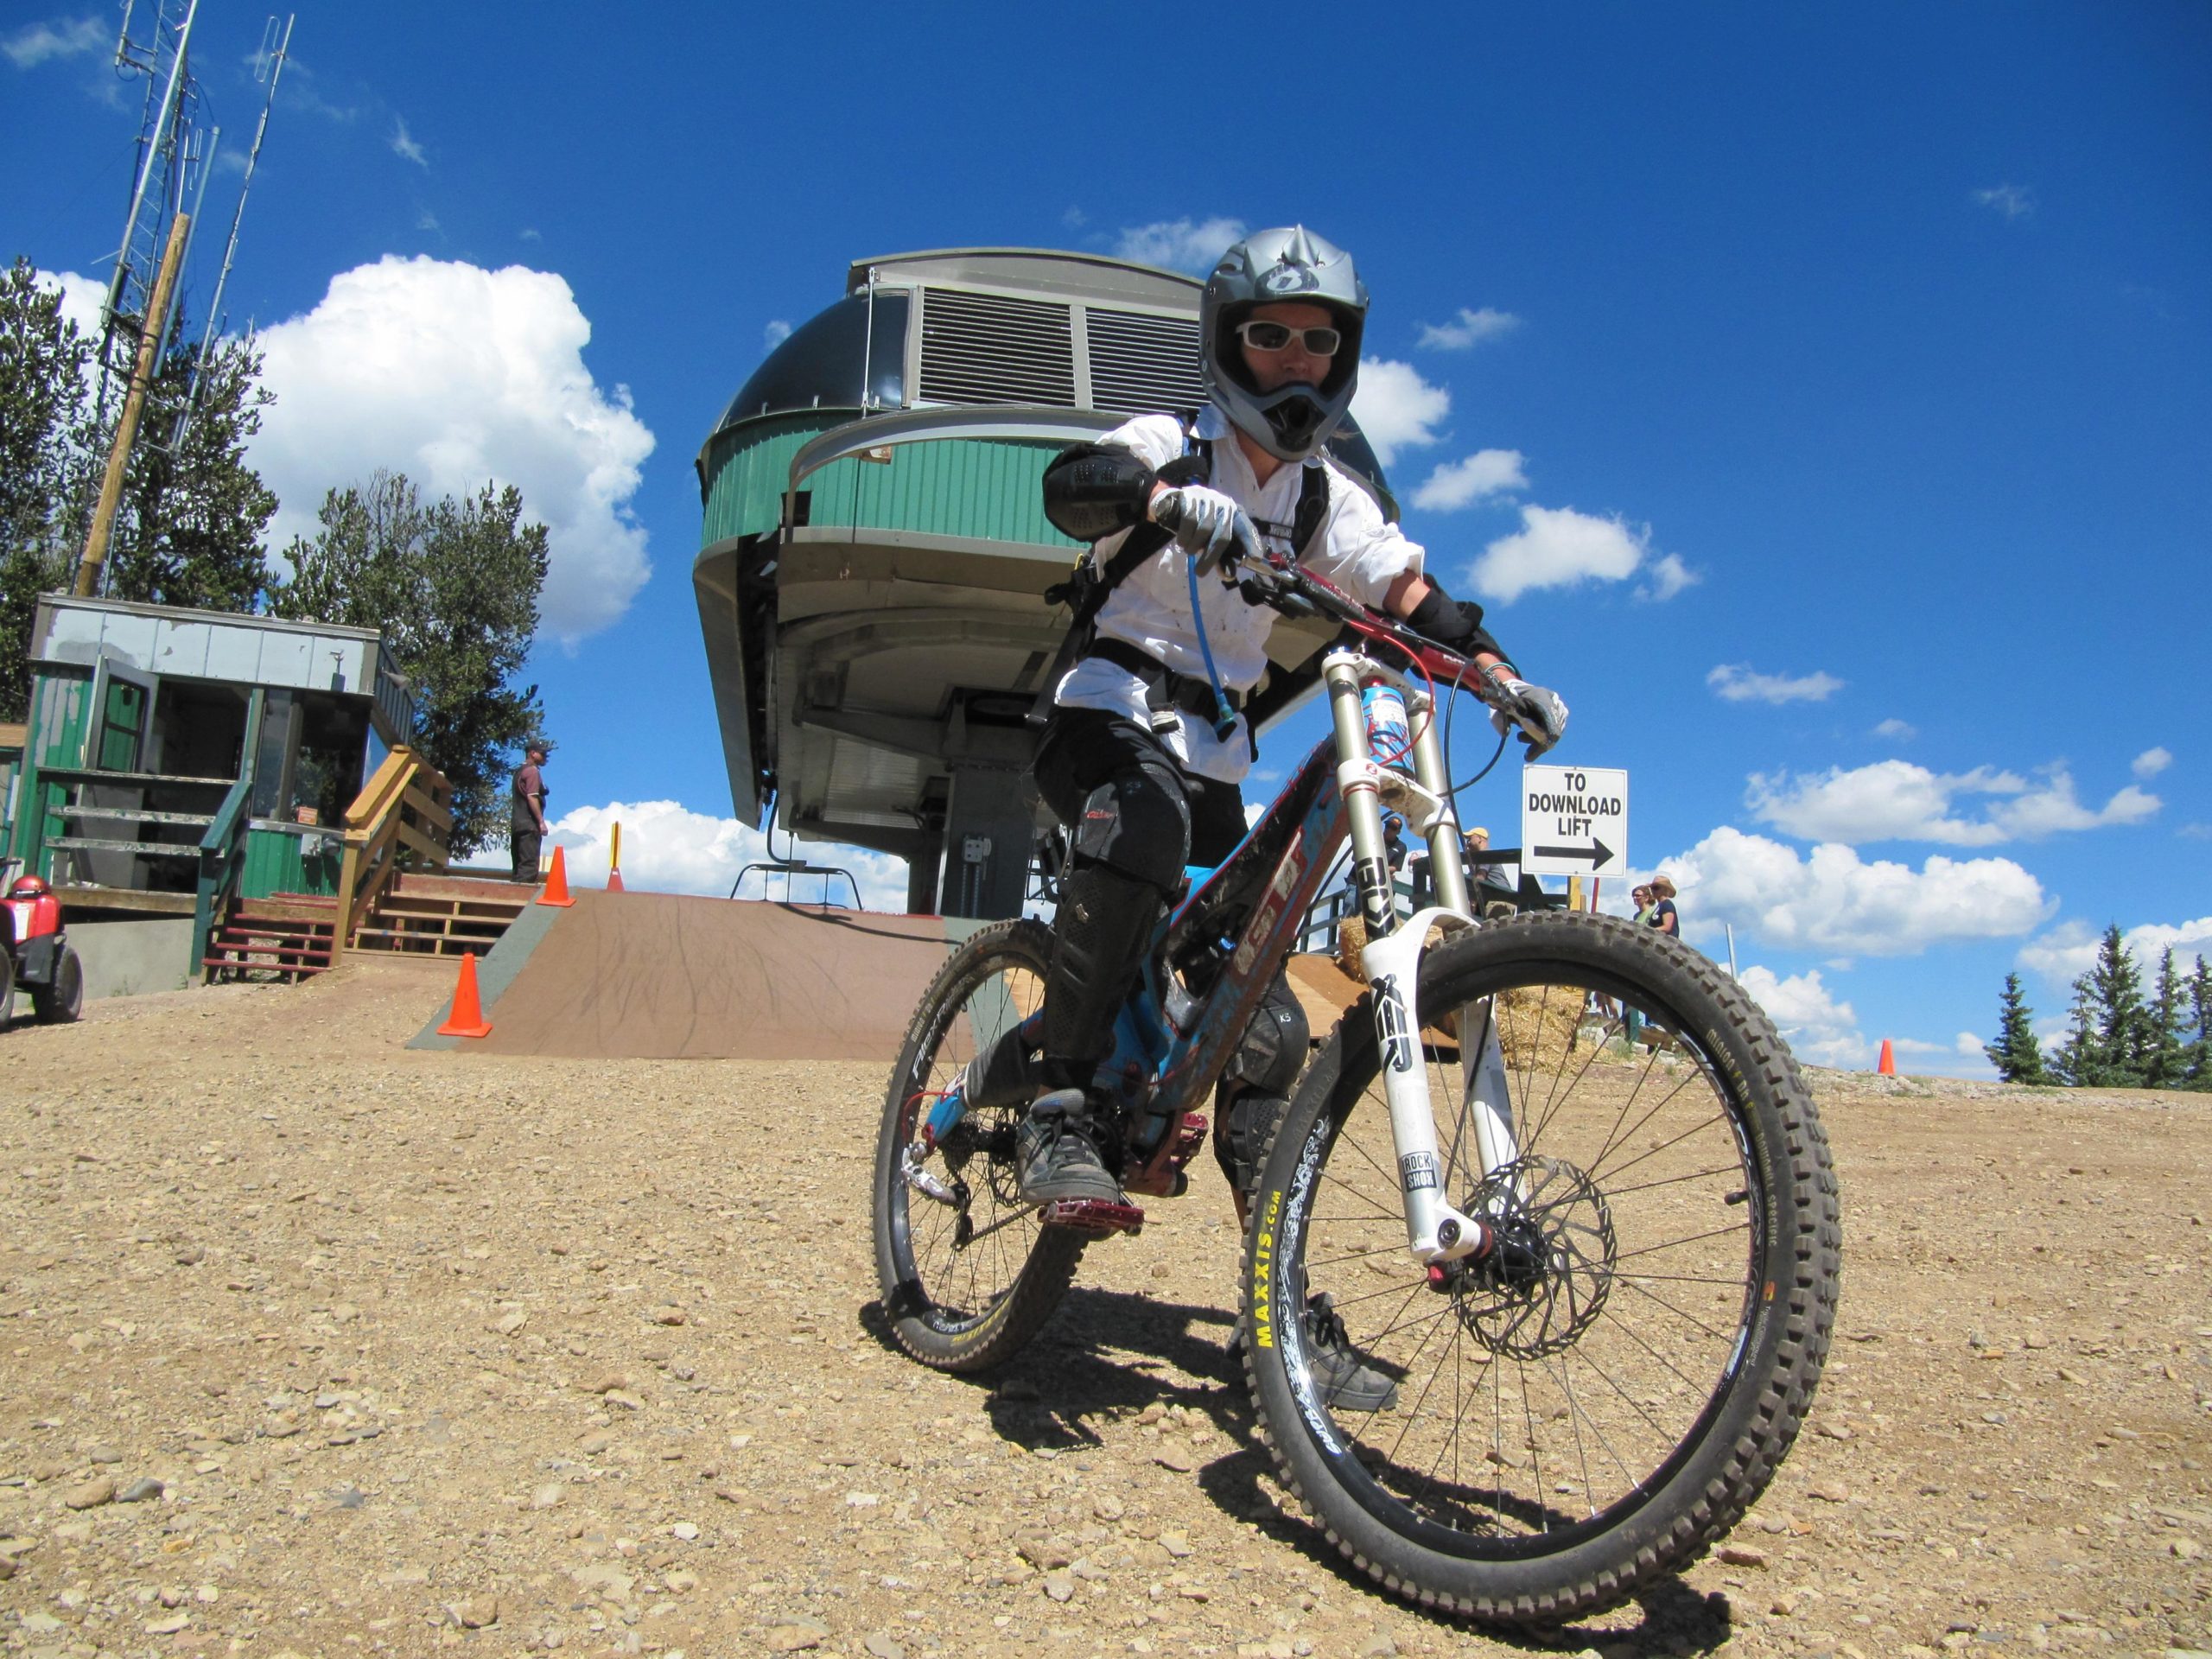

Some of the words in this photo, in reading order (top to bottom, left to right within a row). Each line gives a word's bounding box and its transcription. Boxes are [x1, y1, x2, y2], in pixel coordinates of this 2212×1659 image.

[1564, 772, 1586, 792] TO
[1529, 793, 1621, 816] DOWNLOAD
[1558, 817, 1592, 837] LIFT
[1404, 1154, 1431, 1173] ROCK
[1407, 1171, 1434, 1189] SHOX
[1756, 1132, 1775, 1191] DOWNHILL
[1767, 1194, 1777, 1246] SPECIFIC
